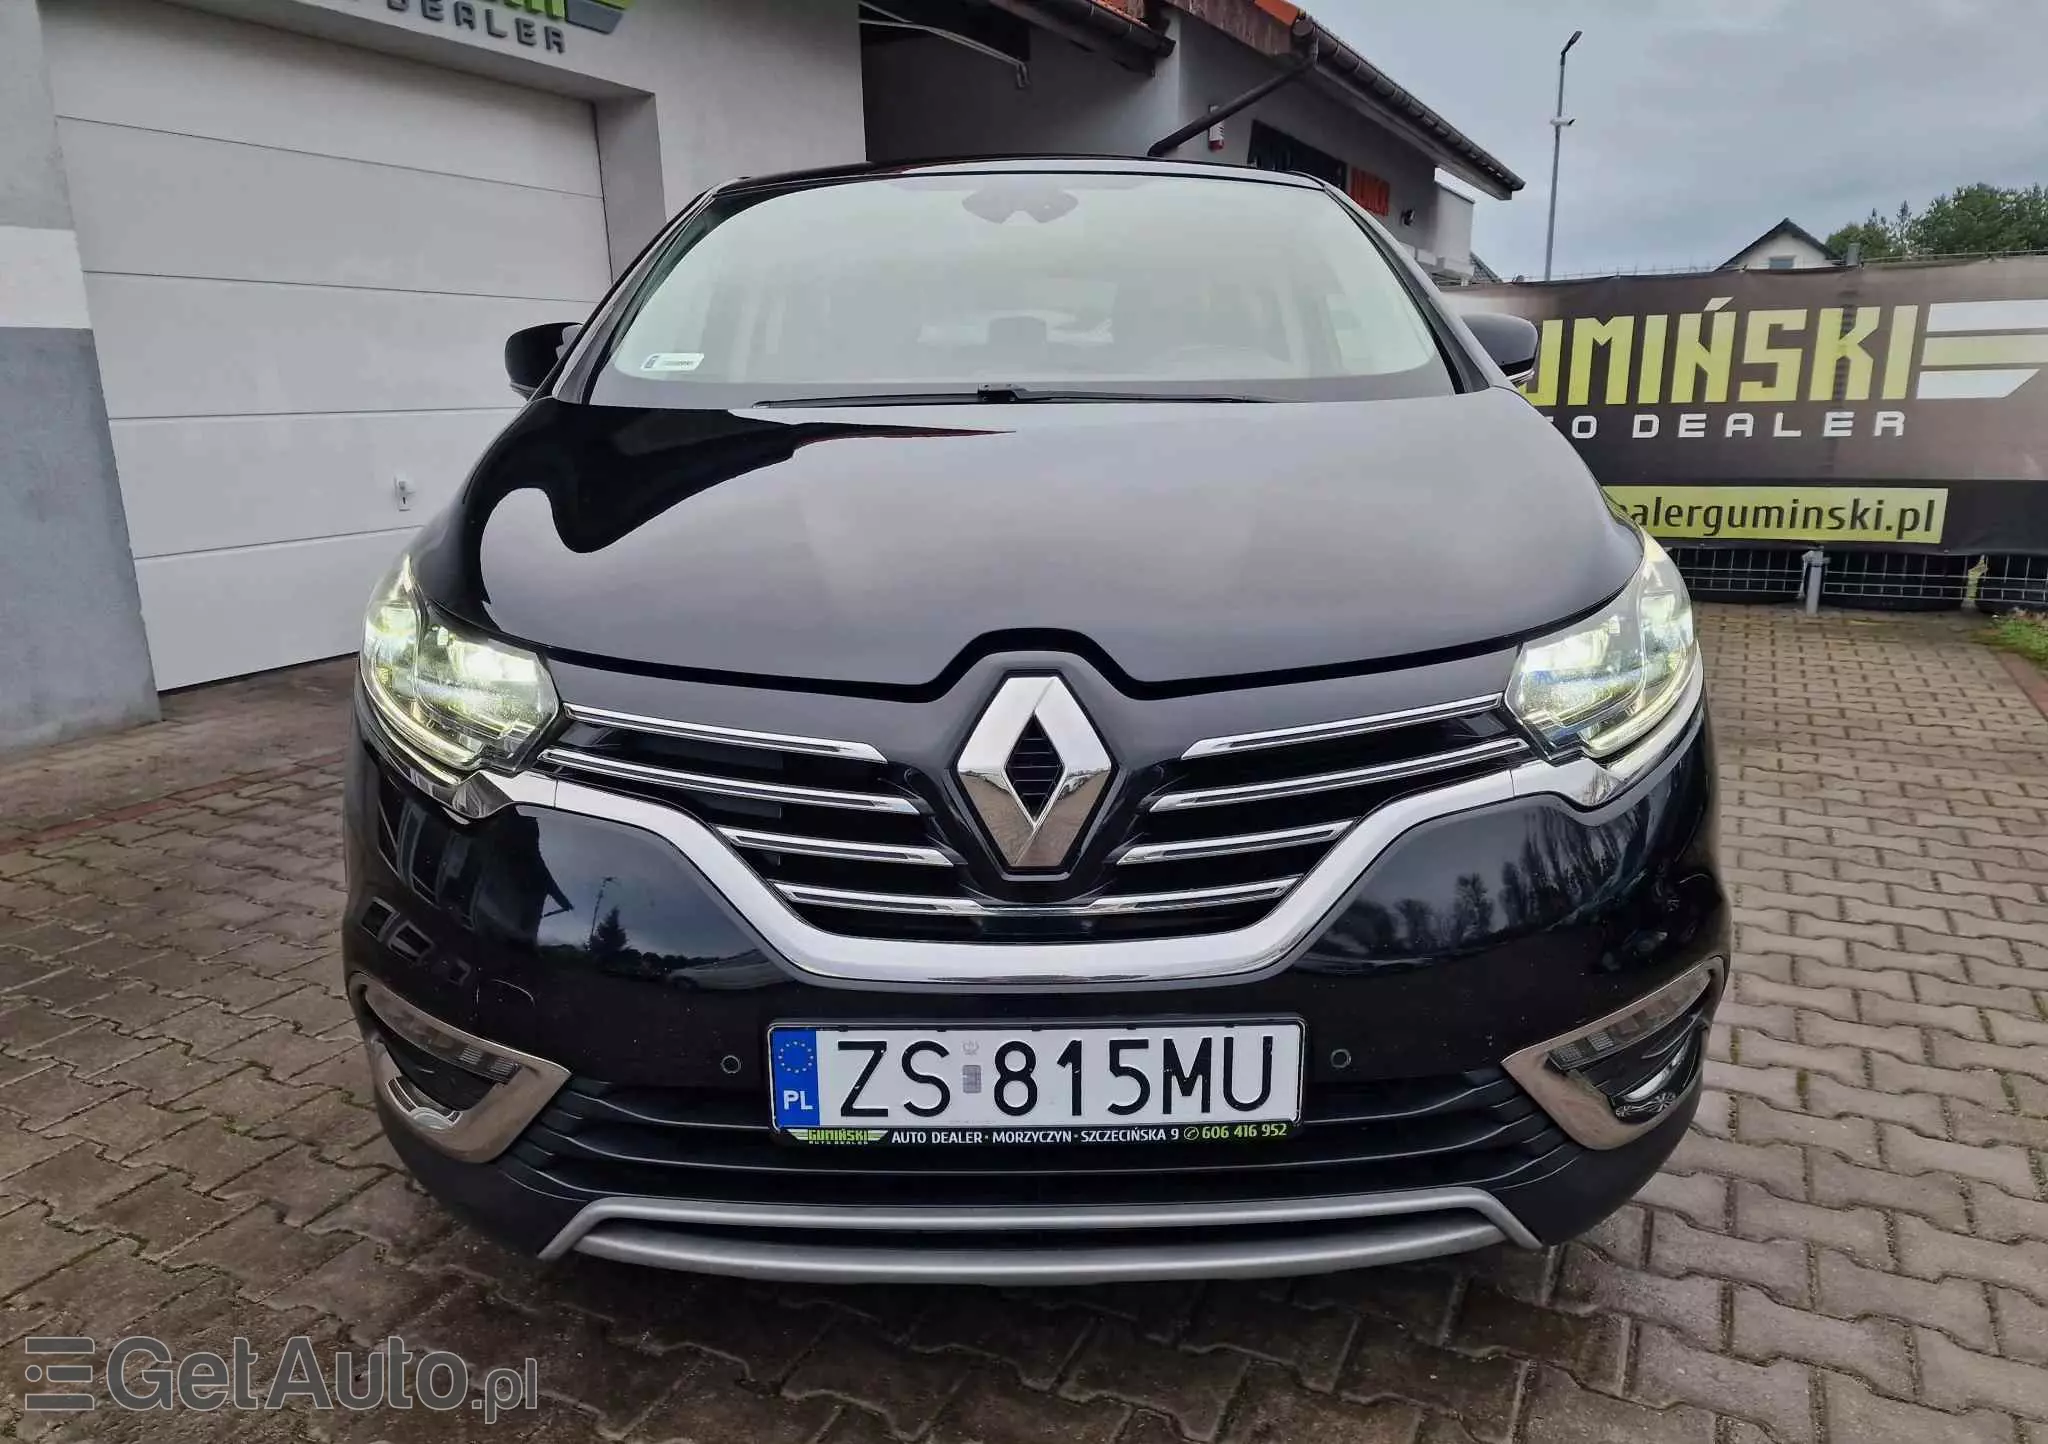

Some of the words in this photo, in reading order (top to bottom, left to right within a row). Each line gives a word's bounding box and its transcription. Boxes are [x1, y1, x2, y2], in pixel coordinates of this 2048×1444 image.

[1632, 411, 1906, 439] DEALER
[838, 1040, 951, 1118] ZS
[993, 1036, 1274, 1117] 815MU
[784, 1089, 814, 1111] PL
[891, 1131, 927, 1144] AUTO
[932, 1131, 983, 1144] DEALER
[992, 1129, 1072, 1143] MORZYCZYN
[1080, 1127, 1167, 1142] SZCZECIŃSKA
[1170, 1128, 1180, 1140] 9
[1201, 1125, 1230, 1139] 606
[1233, 1125, 1258, 1138] 416
[1261, 1123, 1288, 1137] 952
